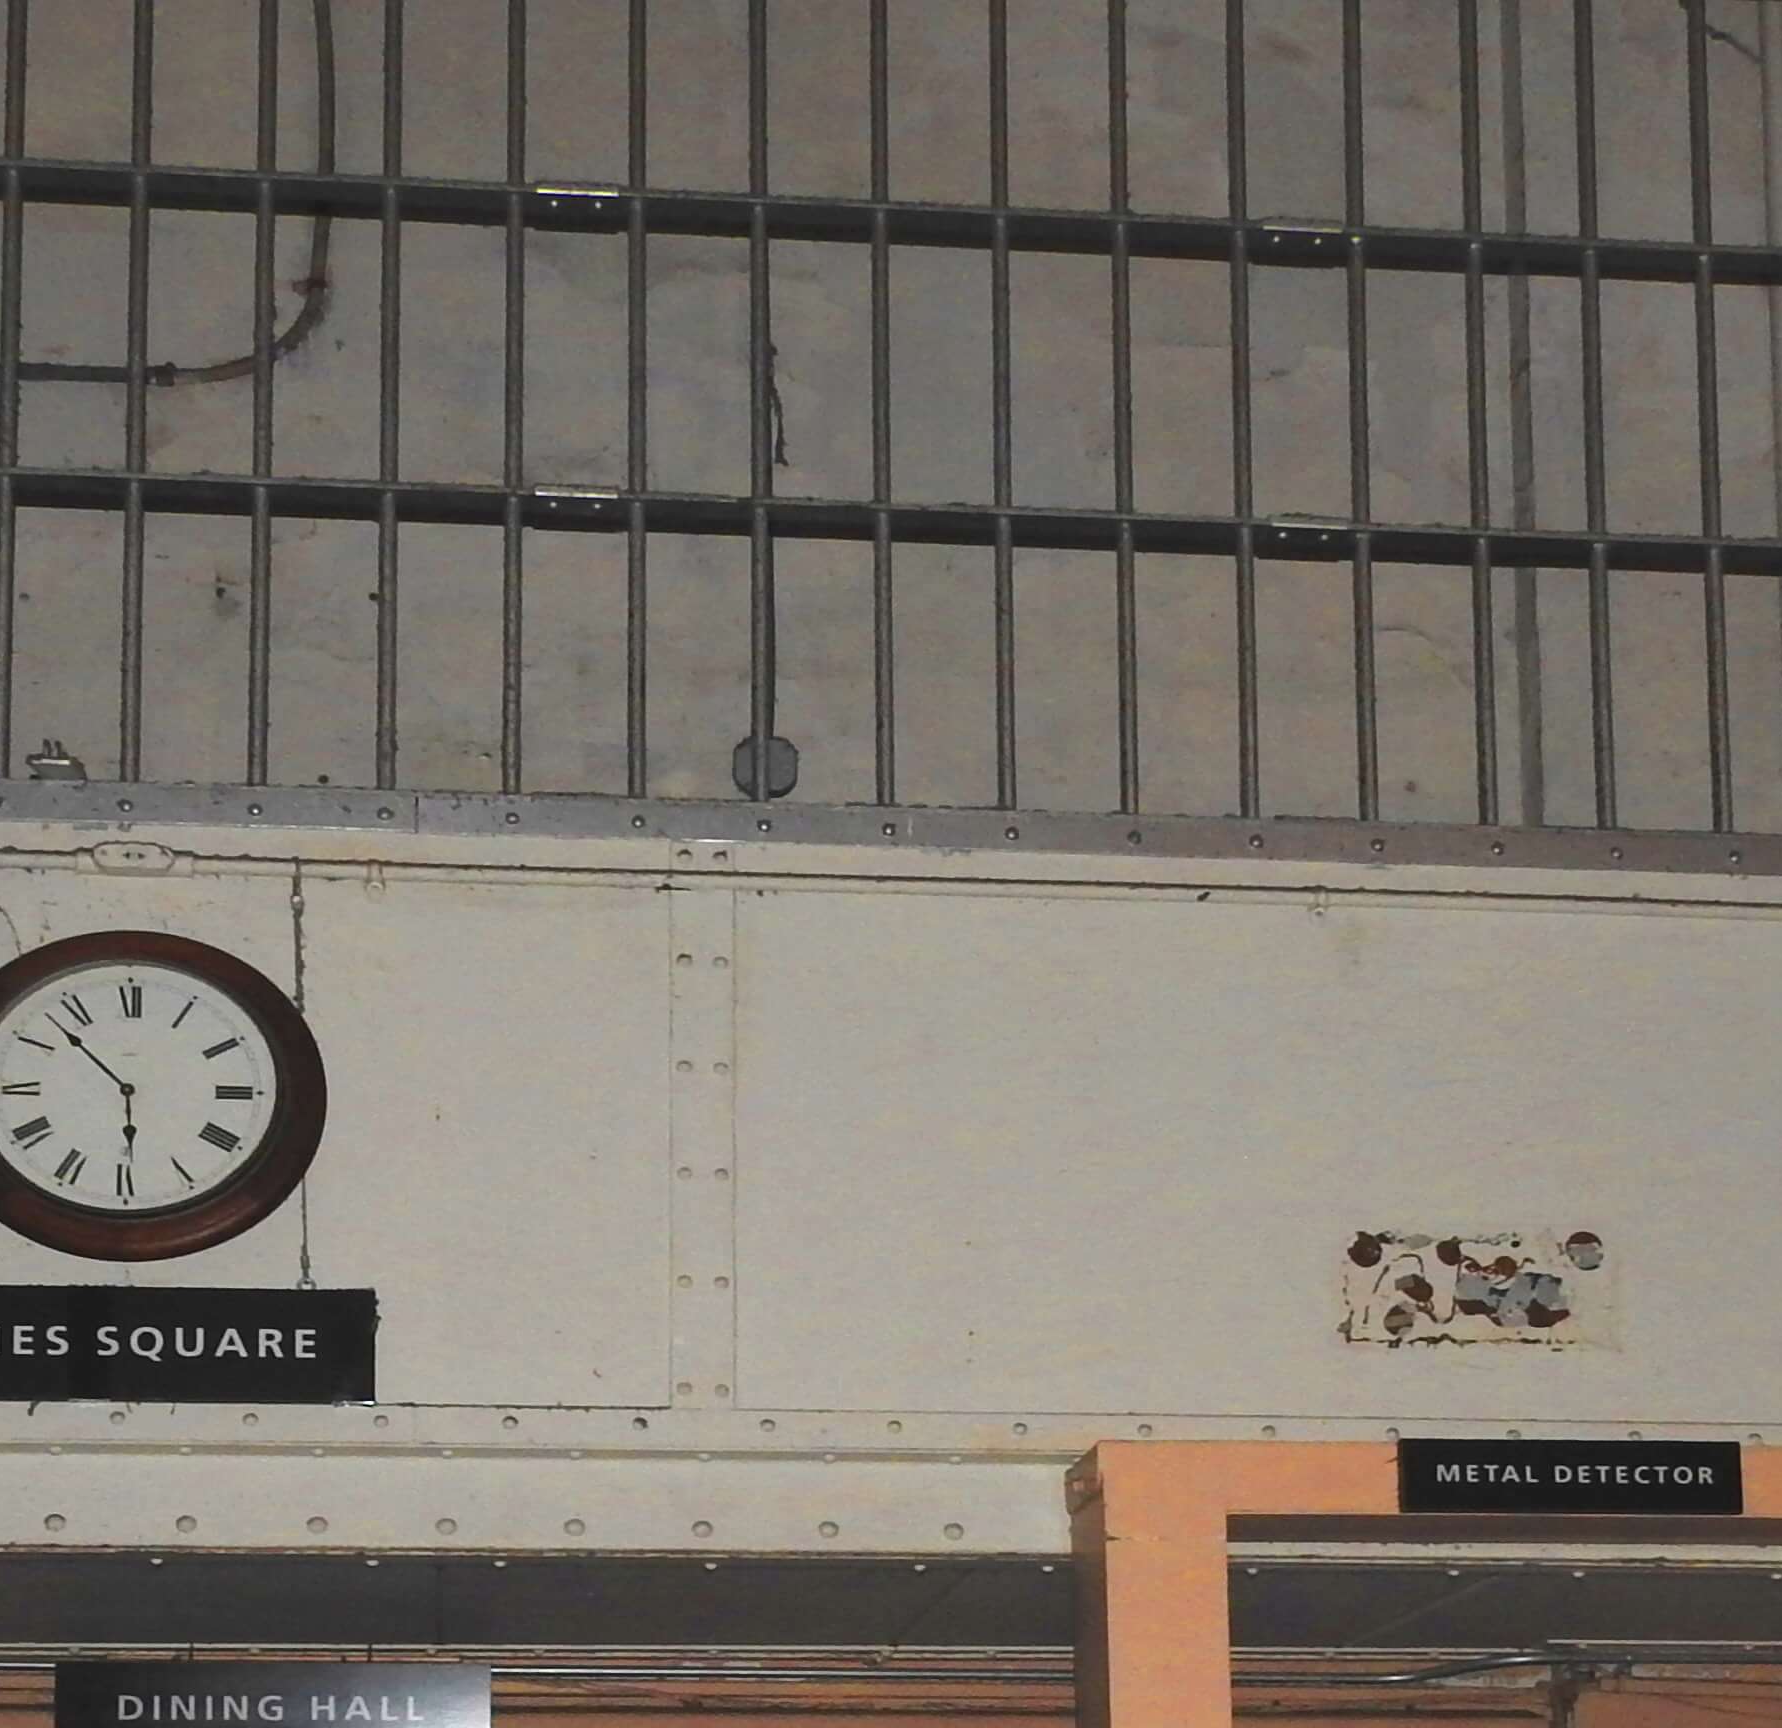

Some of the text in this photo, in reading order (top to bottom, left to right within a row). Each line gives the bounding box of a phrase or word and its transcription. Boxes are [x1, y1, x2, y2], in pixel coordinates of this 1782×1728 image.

[97, 1326, 317, 1362] SQUARE
[1436, 1464, 1714, 1484] METAL DETECTOR
[118, 1694, 425, 1722] DINING HALL
